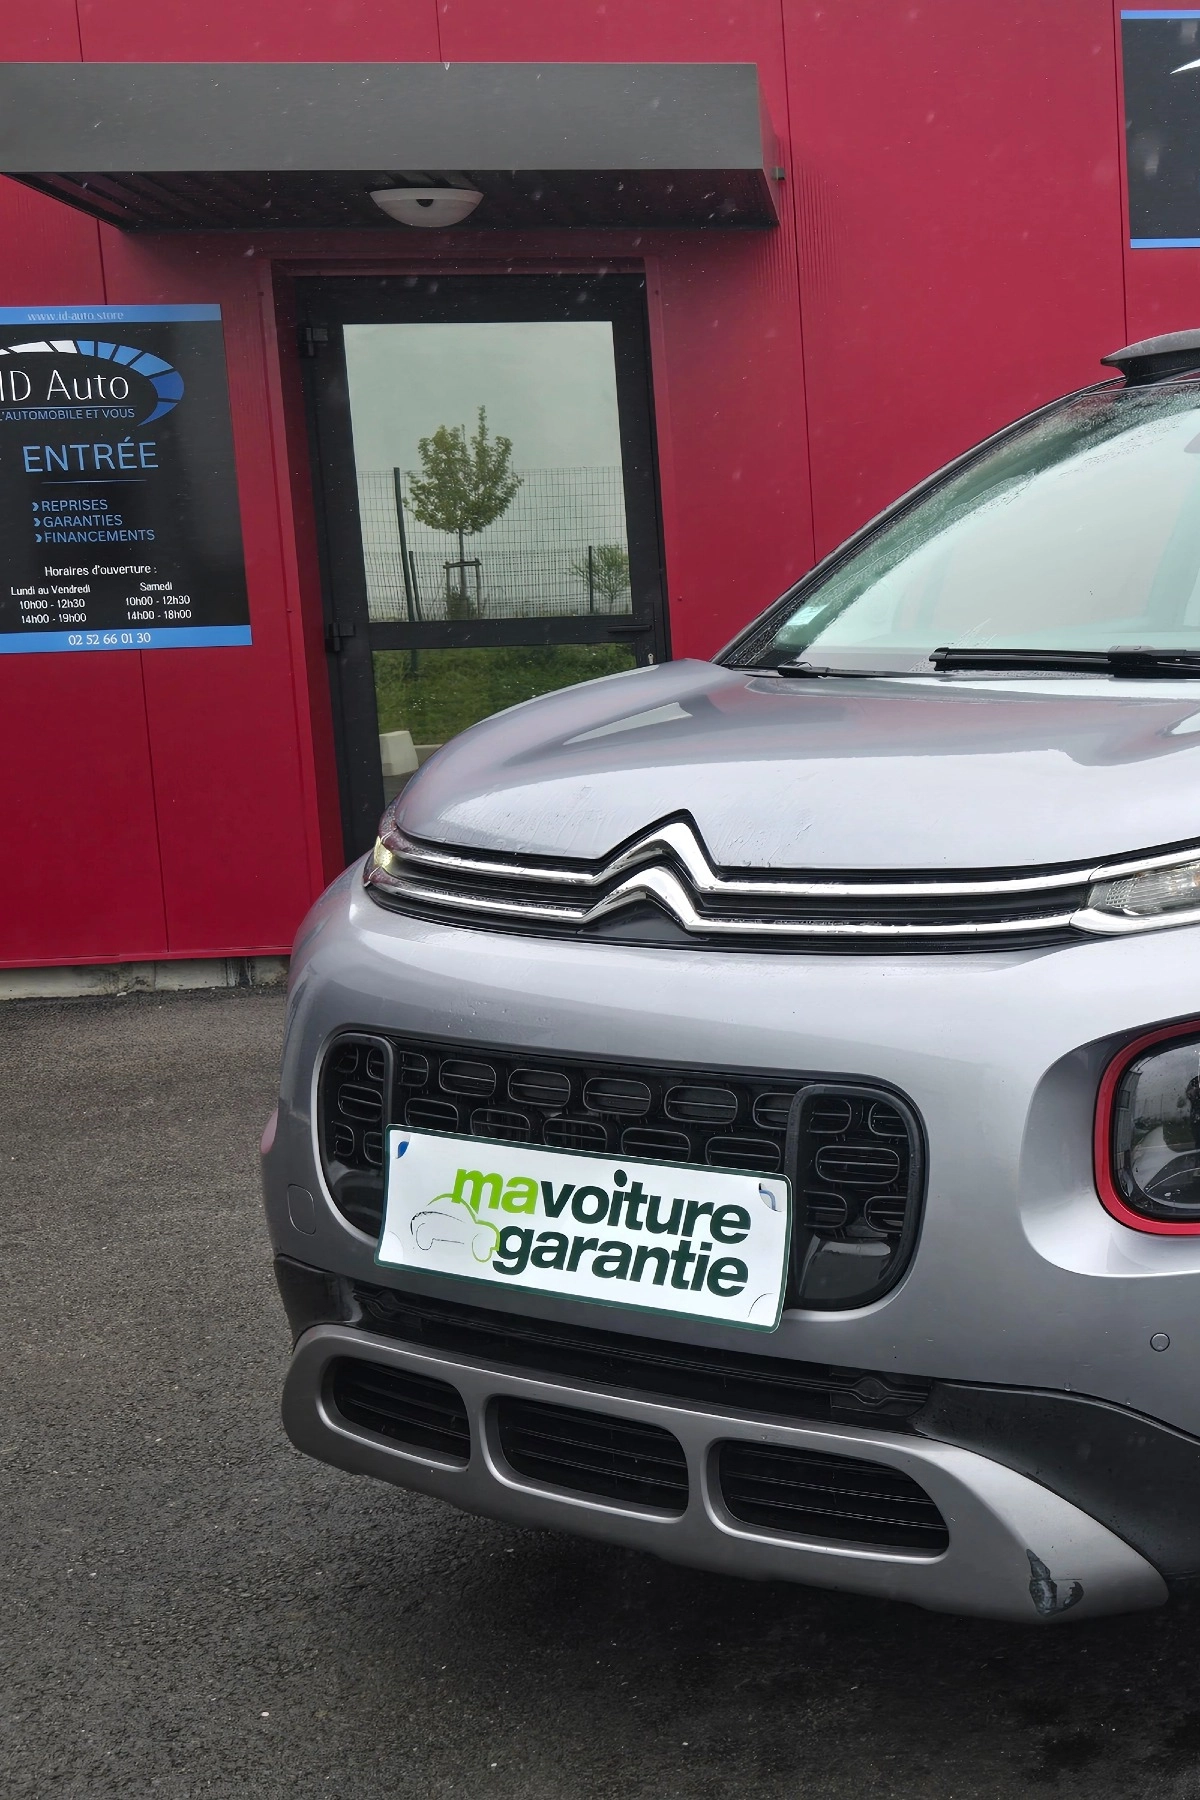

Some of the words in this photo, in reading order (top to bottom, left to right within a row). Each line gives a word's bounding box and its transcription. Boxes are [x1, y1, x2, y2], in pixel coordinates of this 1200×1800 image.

[27, 310, 124, 322] www.id-auto.store
[0, 370, 31, 402] ID
[46, 369, 129, 401] Auto
[0, 409, 83, 421] 'AUTOMOBILE
[85, 410, 99, 419] ET
[101, 408, 135, 418] VOUS
[22, 436, 159, 473] ENTRÉE
[41, 499, 108, 512] REPRISES
[43, 514, 123, 528] GARANTIES
[44, 529, 156, 543] FINANCEMENTS
[44, 565, 89, 577] Horaires
[10, 586, 36, 596] Lundi
[51, 584, 91, 594] Vendredi
[140, 581, 173, 591] Samedi
[19, 600, 48, 610] 10h00
[57, 598, 86, 609] 12h30
[125, 597, 153, 607] 10h00
[162, 595, 191, 606] 12h30
[21, 614, 50, 624] 14h00
[58, 612, 87, 623] 19h00
[127, 610, 155, 621] 14h00
[164, 609, 192, 619] 18h00
[68, 635, 84, 646] 02
[86, 634, 100, 645] 52
[103, 633, 118, 644] 66
[121, 633, 133, 644] 01
[136, 632, 152, 643] 30
[492, 1224, 750, 1298] garantie
